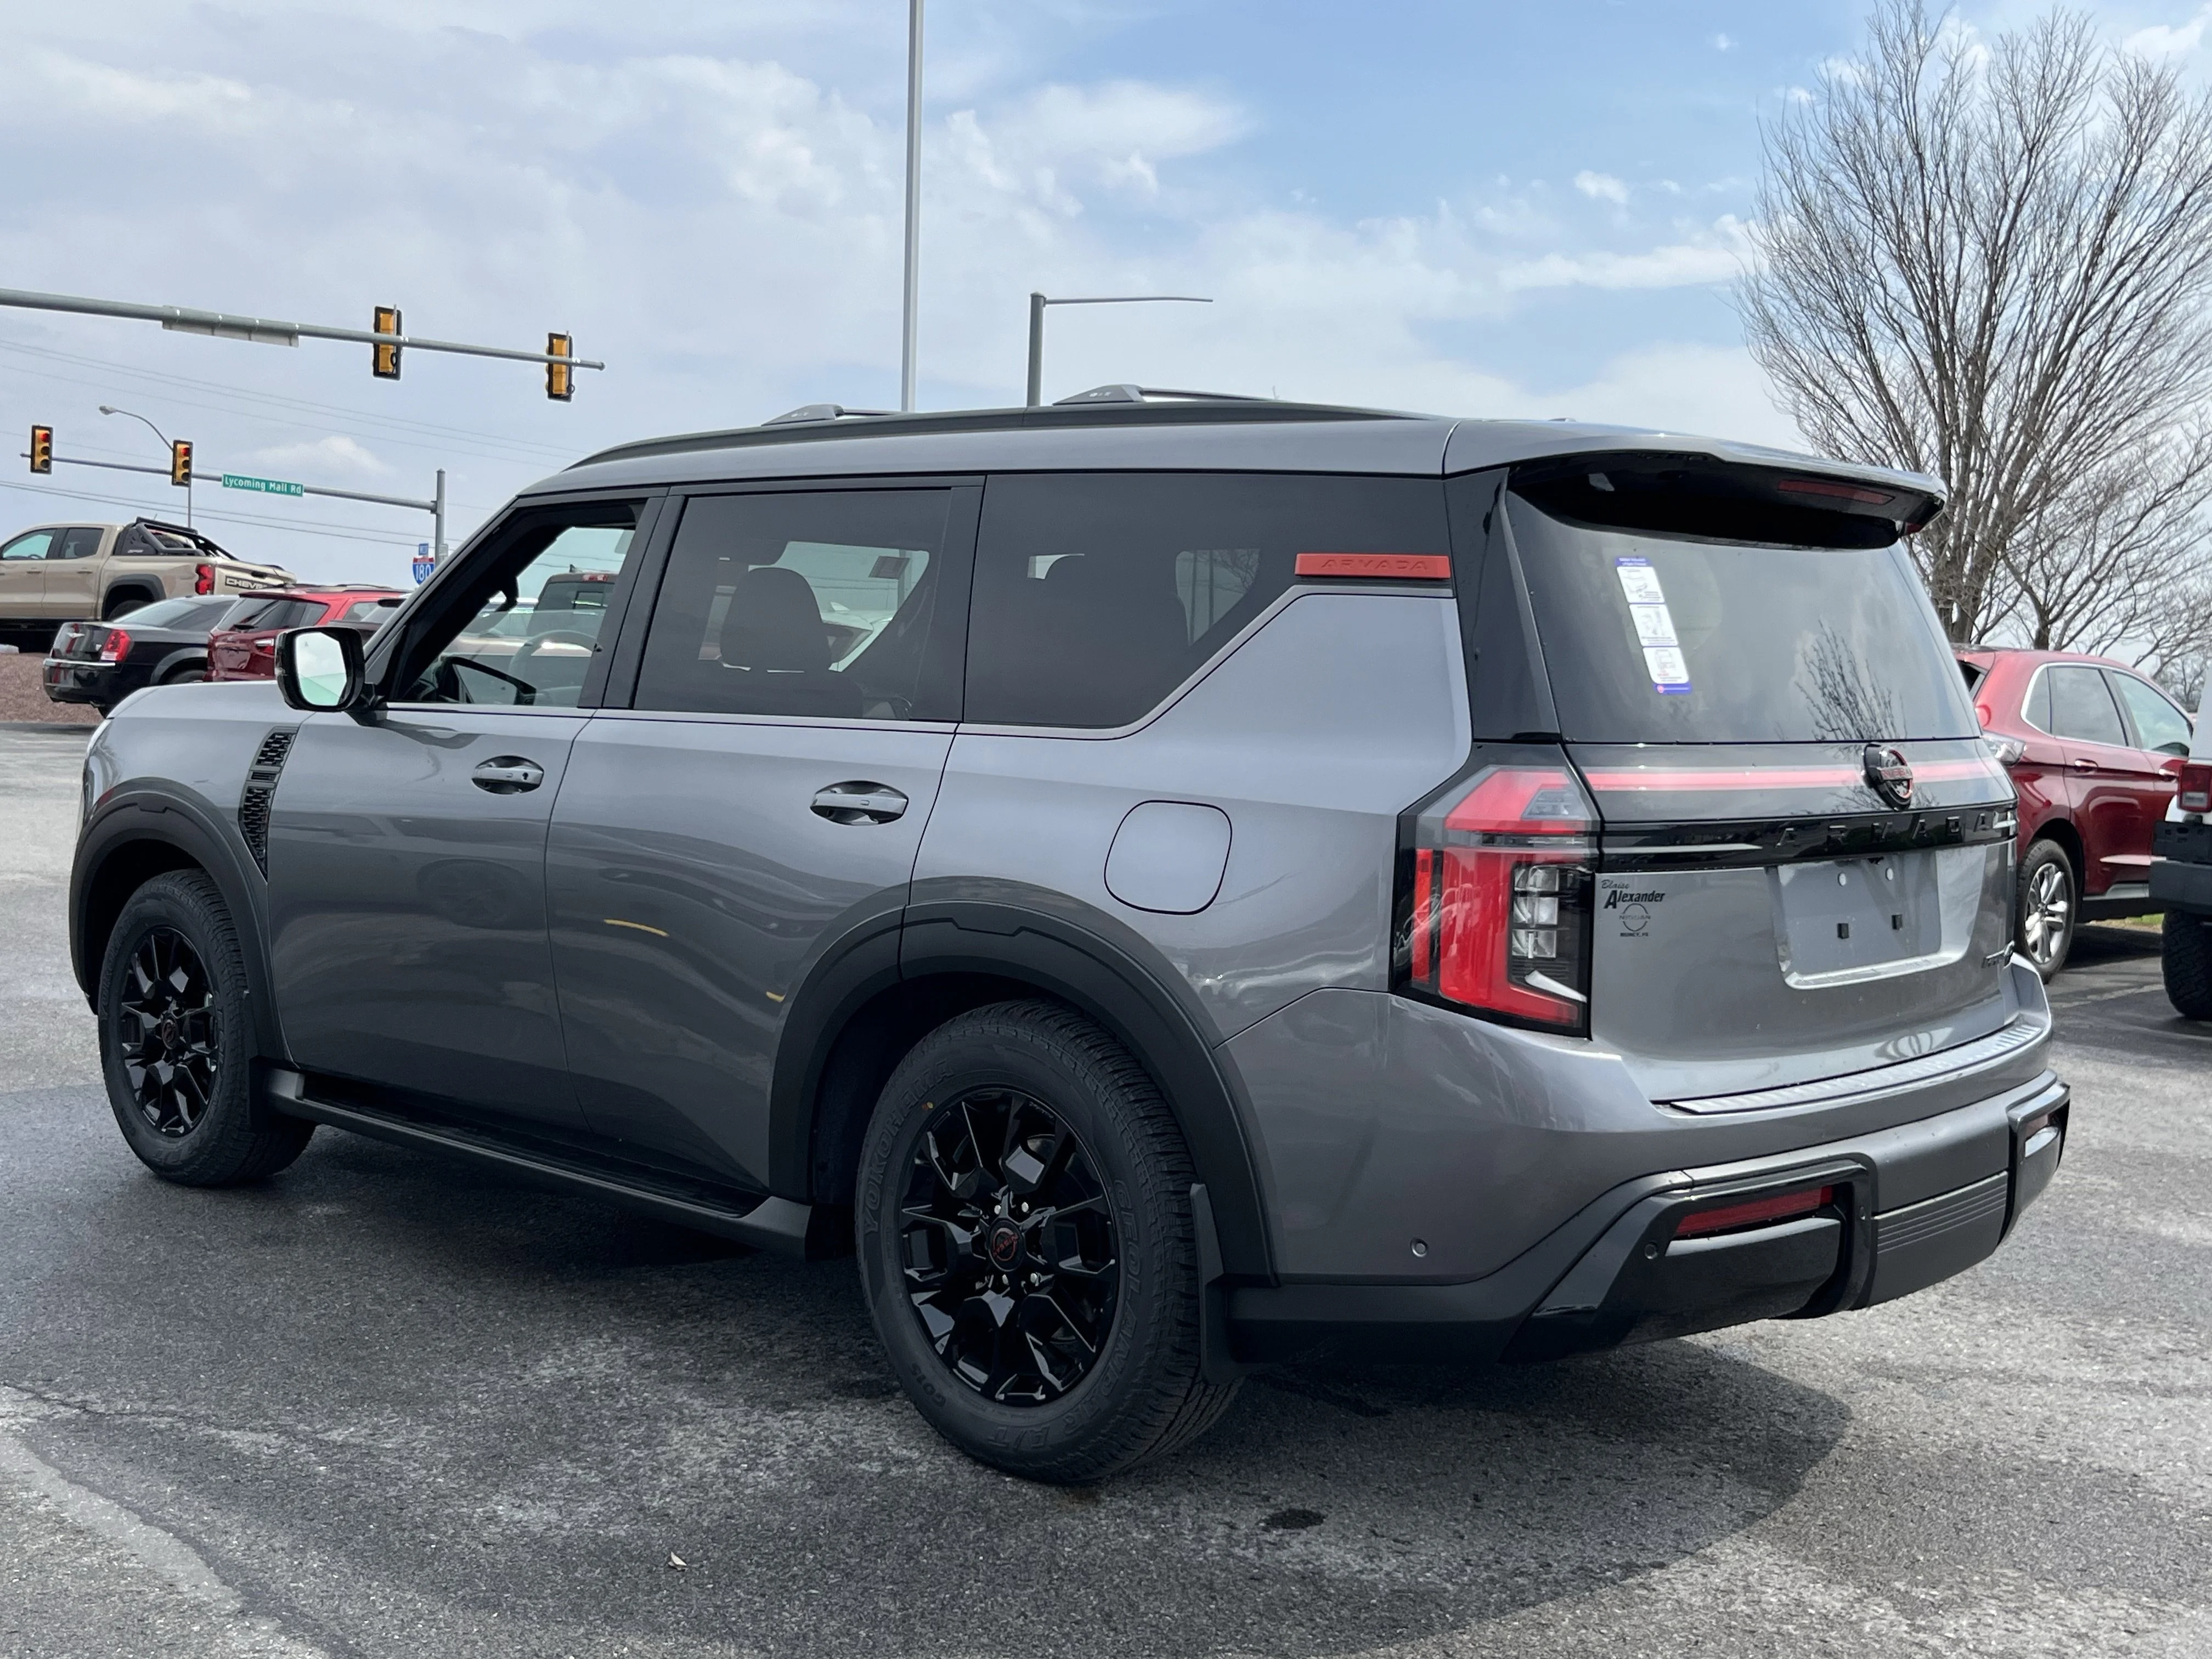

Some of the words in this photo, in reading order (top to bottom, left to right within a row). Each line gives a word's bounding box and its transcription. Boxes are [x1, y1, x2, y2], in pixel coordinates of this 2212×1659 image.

[224, 476, 266, 492] Lycoming
[269, 482, 287, 492] Mall
[291, 485, 301, 494] Rd
[415, 565, 431, 581] 180
[1321, 559, 1429, 571] ARMADA
[1774, 812, 1991, 849] ARMADA
[1601, 879, 1630, 889] Blaise
[1603, 890, 1666, 909] Alexander
[863, 1058, 955, 1234] YOKOHAMA
[1064, 1179, 1141, 1436] GEOLANDAR
[988, 1425, 1051, 1452] A/T
